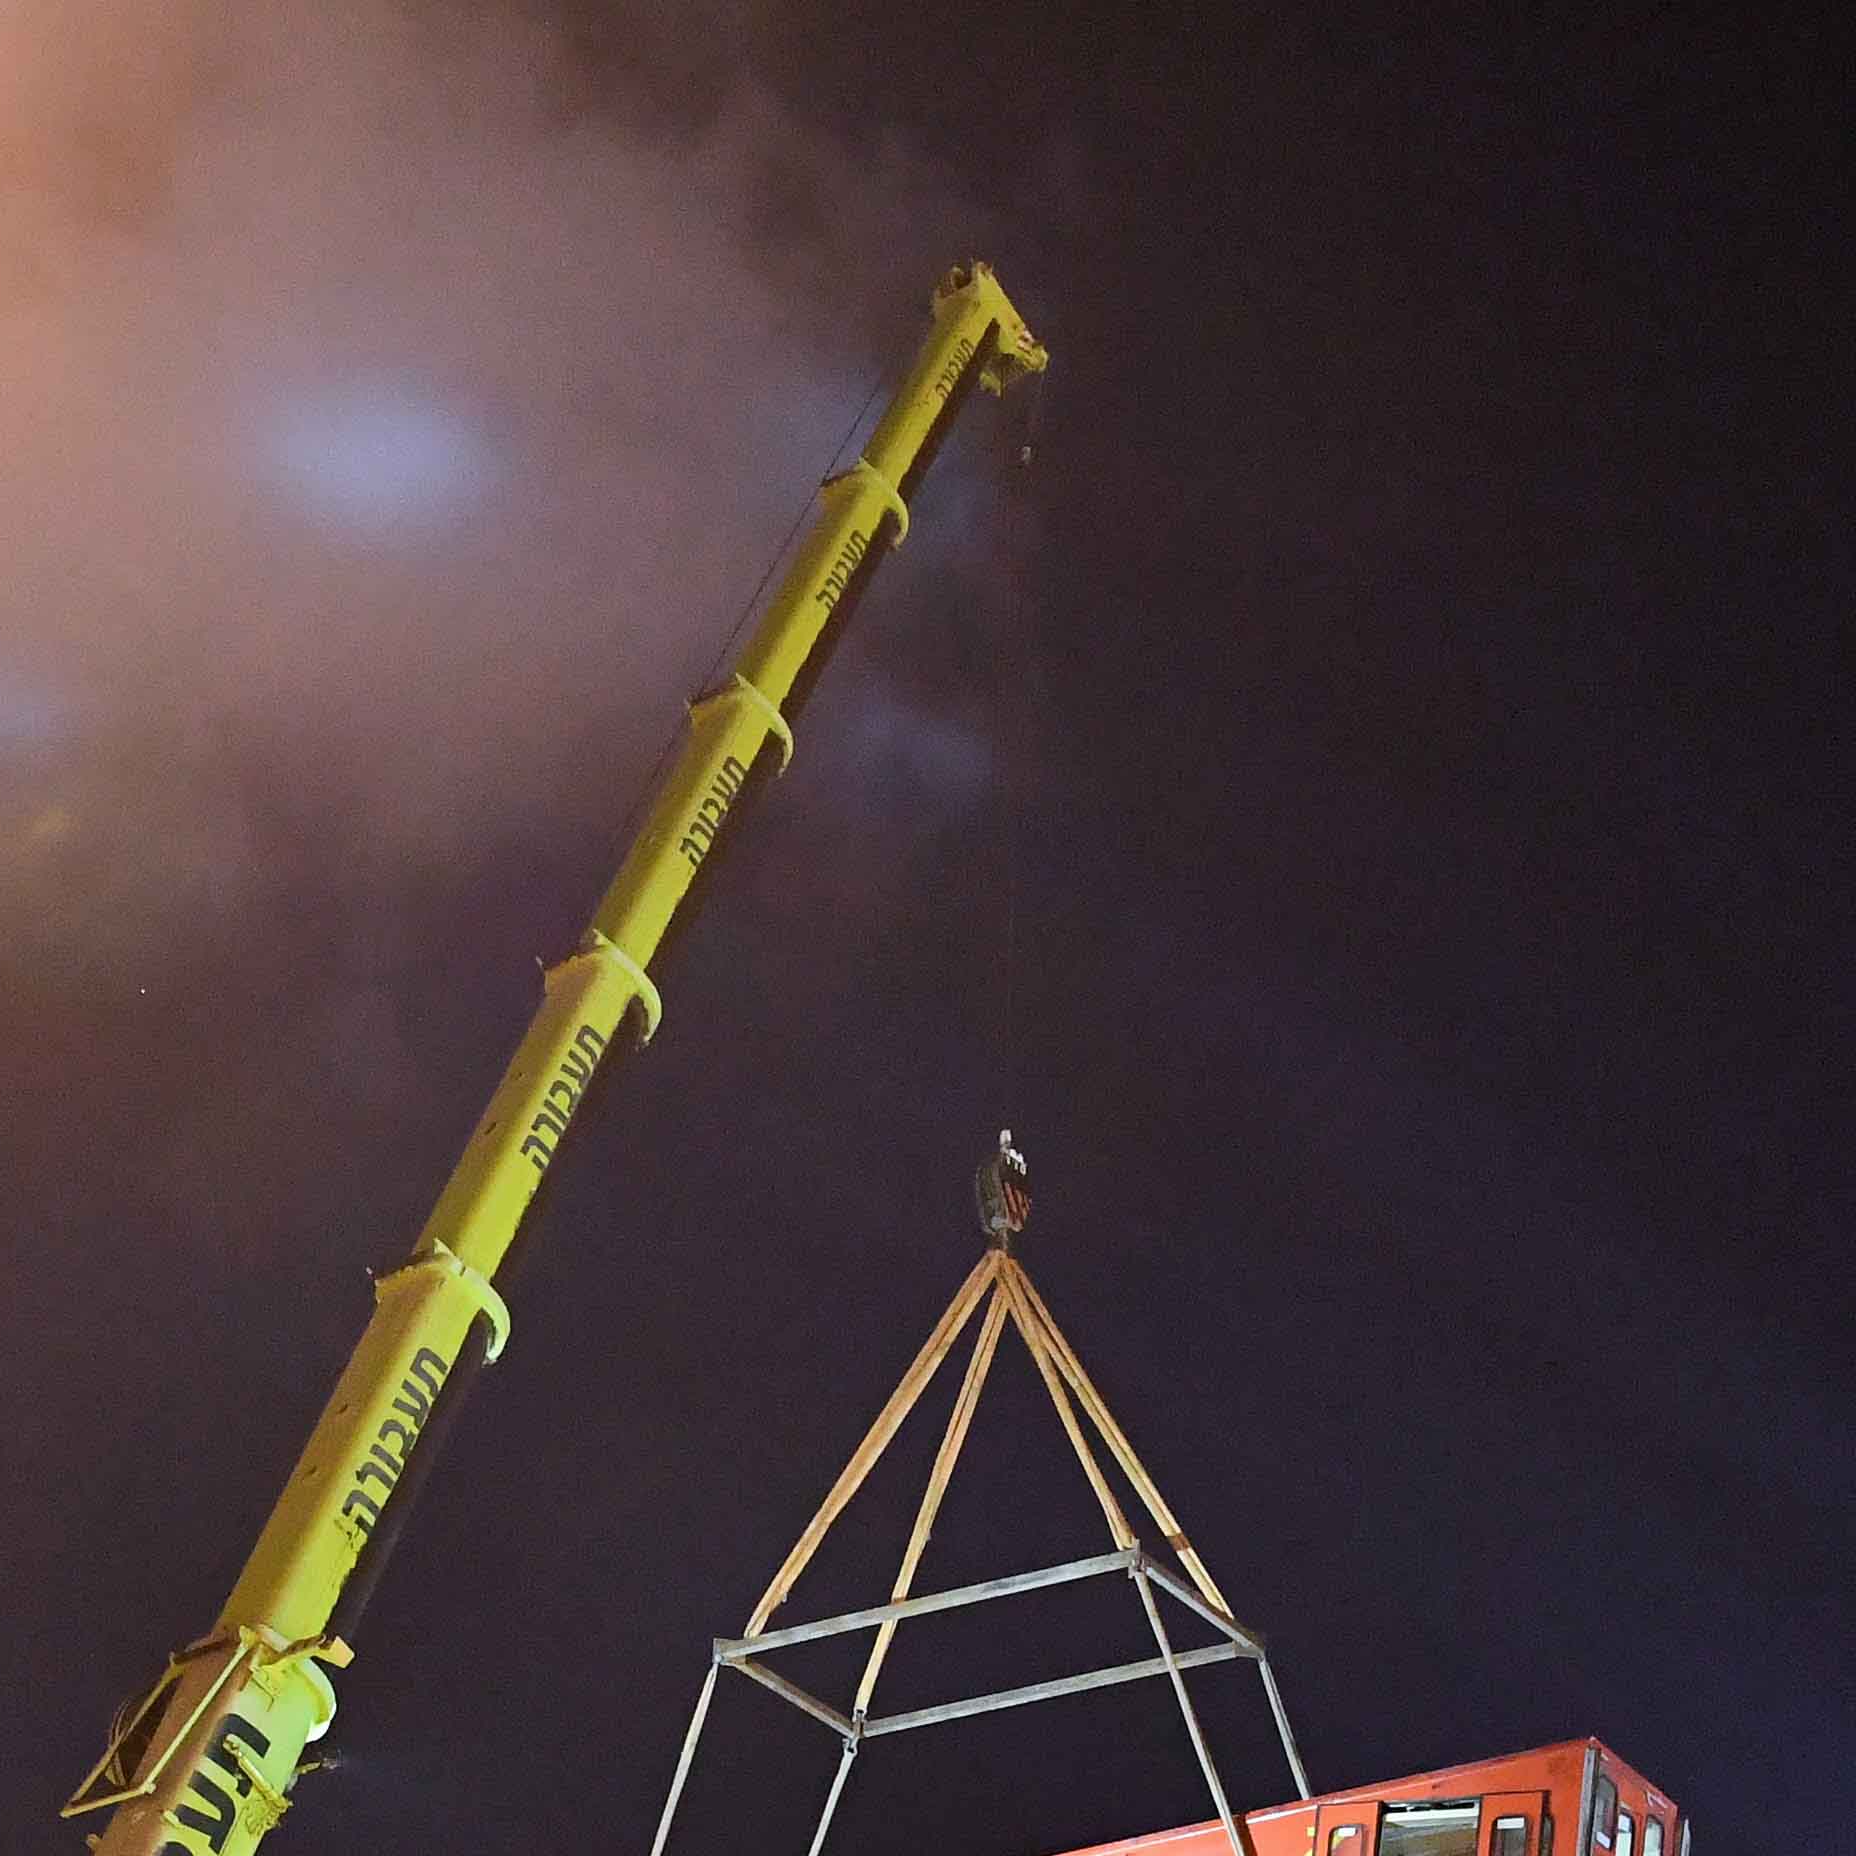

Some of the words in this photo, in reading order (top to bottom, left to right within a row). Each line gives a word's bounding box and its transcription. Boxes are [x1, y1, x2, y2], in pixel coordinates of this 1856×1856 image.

[815, 529, 870, 612] תעבורה
[679, 755, 747, 866] תעבורה
[519, 1024, 608, 1171] תעבורה
[342, 1346, 450, 1535] תעבורה
